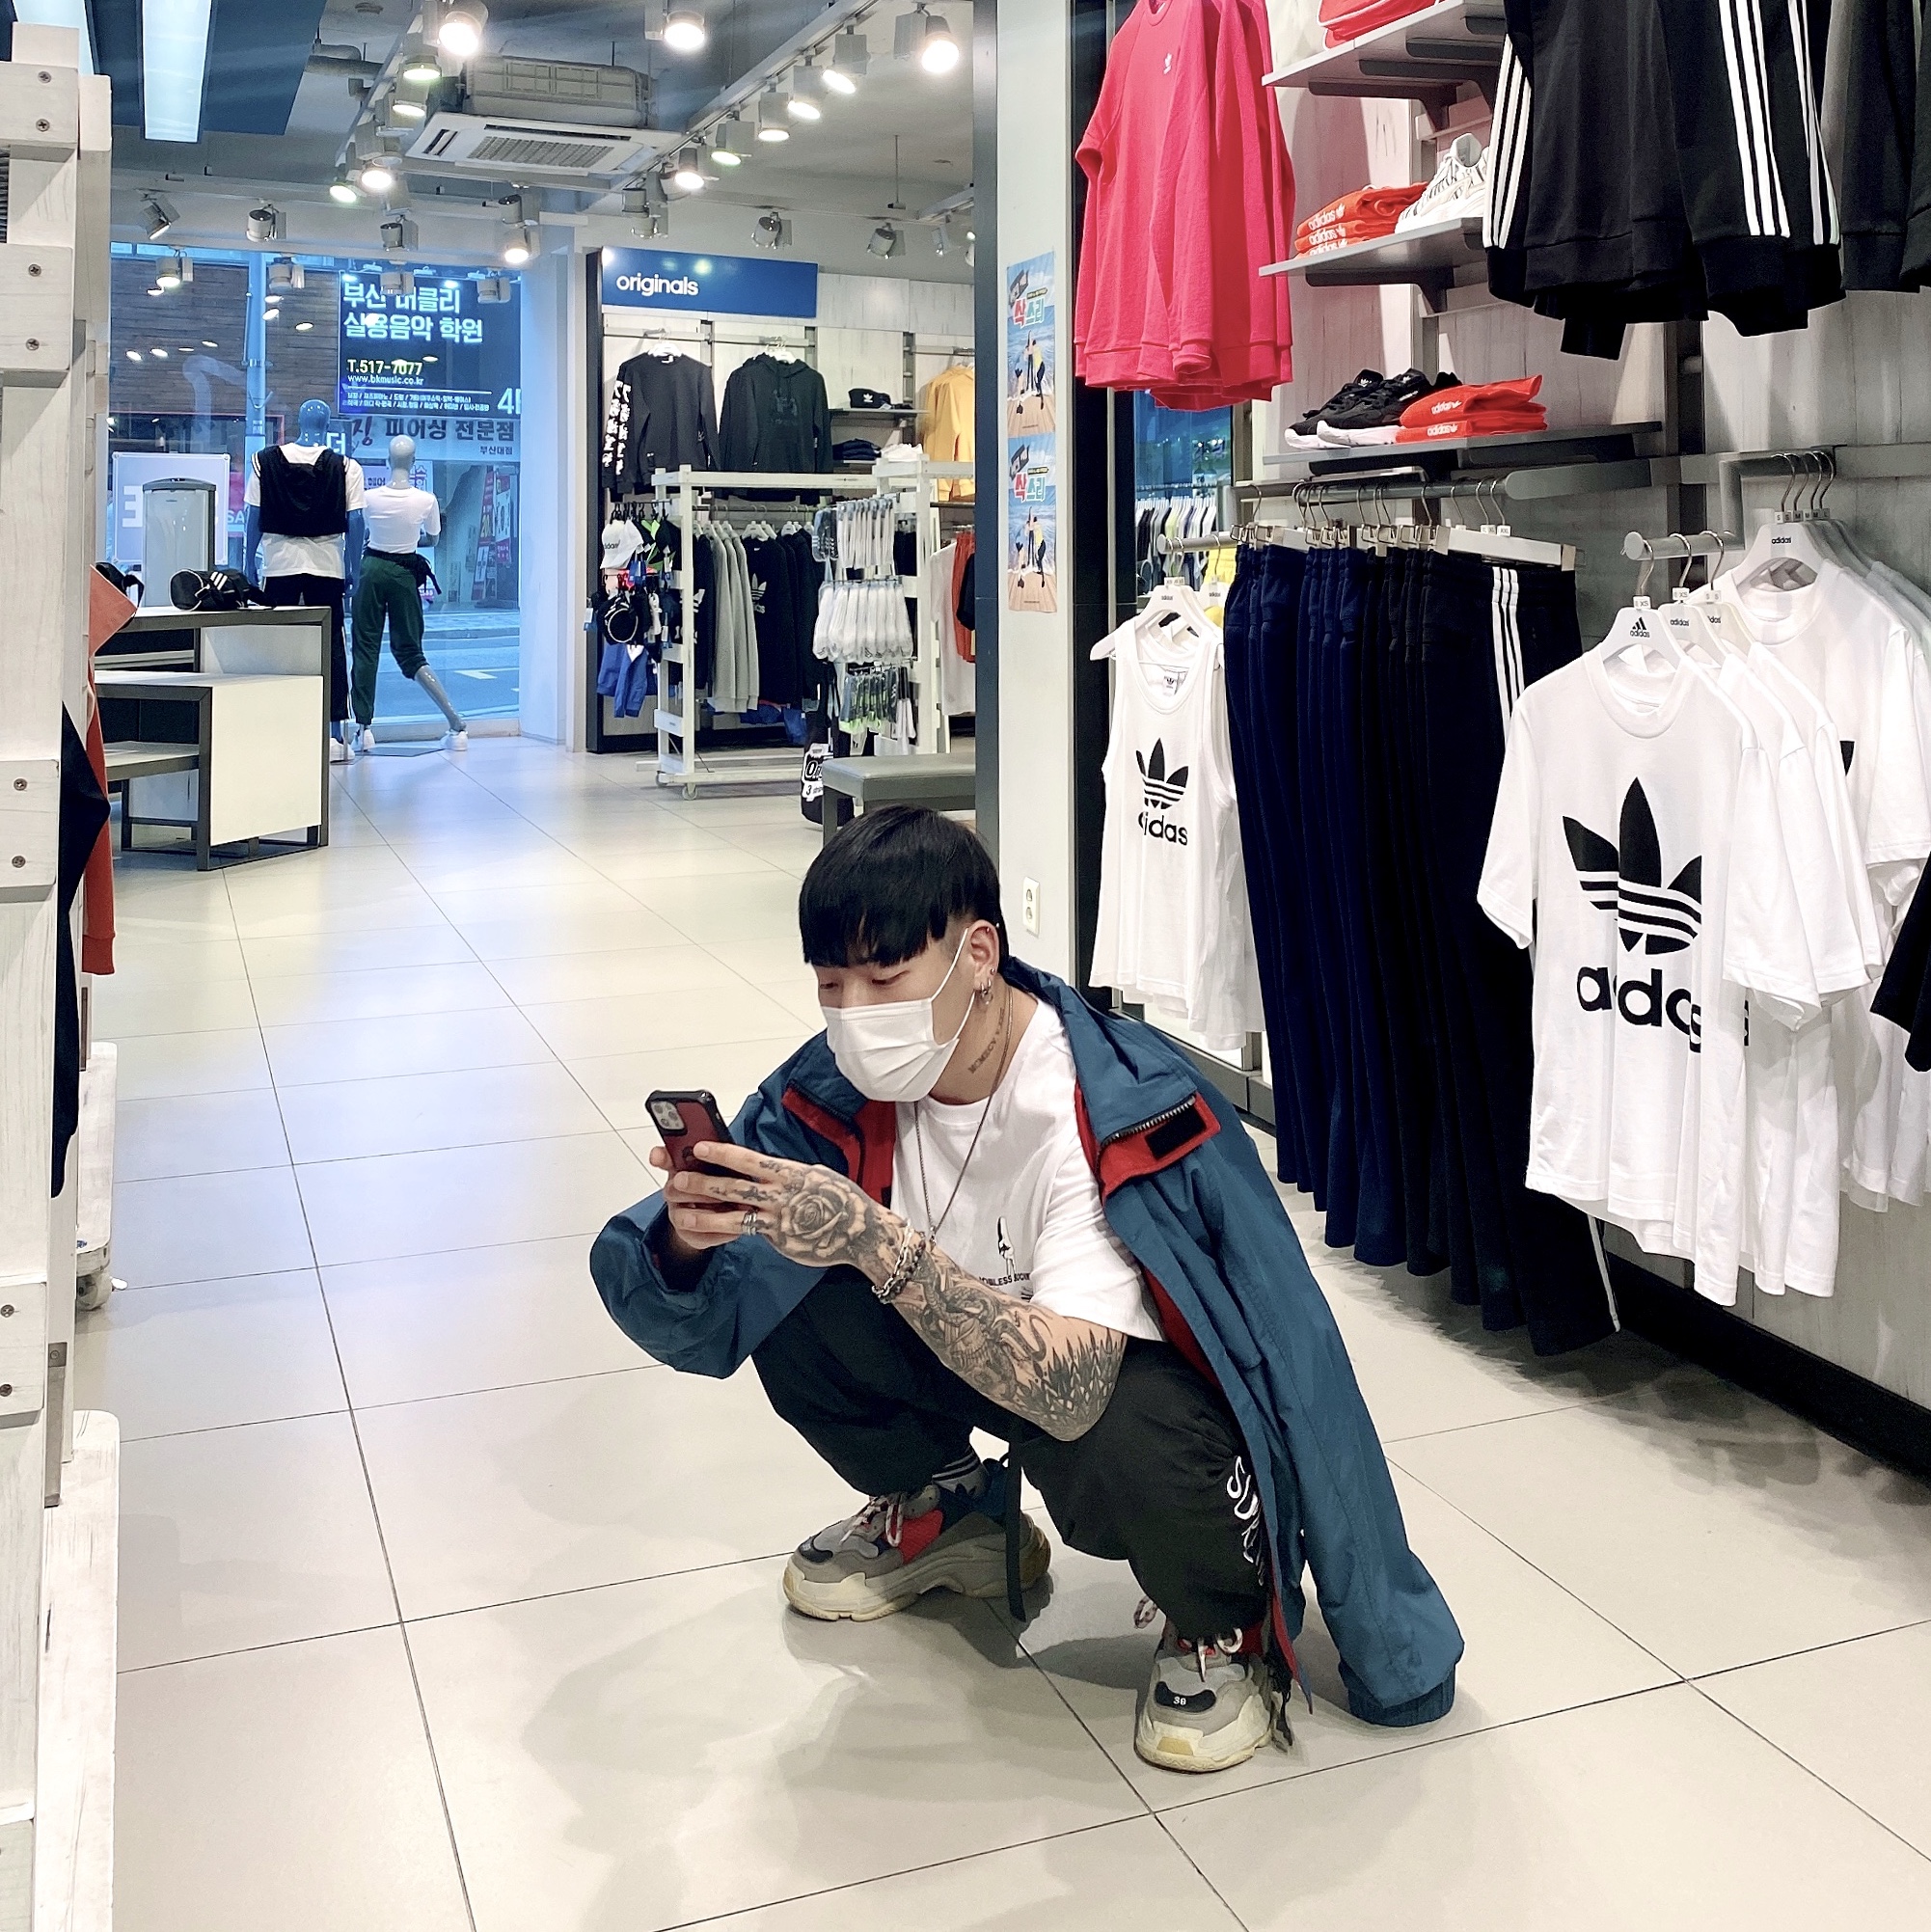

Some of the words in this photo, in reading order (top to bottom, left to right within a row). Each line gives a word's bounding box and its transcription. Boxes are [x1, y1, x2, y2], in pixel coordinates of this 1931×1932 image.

[1308, 209, 1336, 231] adidas
[1308, 227, 1337, 245] adidas
[616, 273, 699, 296] originals
[343, 282, 387, 310] 부산
[343, 312, 434, 342] 실용음악
[439, 316, 483, 343] 학원
[347, 374, 424, 386] www.bkmusic.co.kr
[1430, 401, 1453, 415] adidas
[386, 419, 447, 440] 피어싱
[455, 421, 514, 442] 전문점
[1427, 424, 1451, 437] adidas
[479, 446, 513, 455] 부산대점
[1670, 618, 1690, 627] adidas
[1138, 810, 1188, 846] idas
[1576, 966, 1701, 1054] ada
